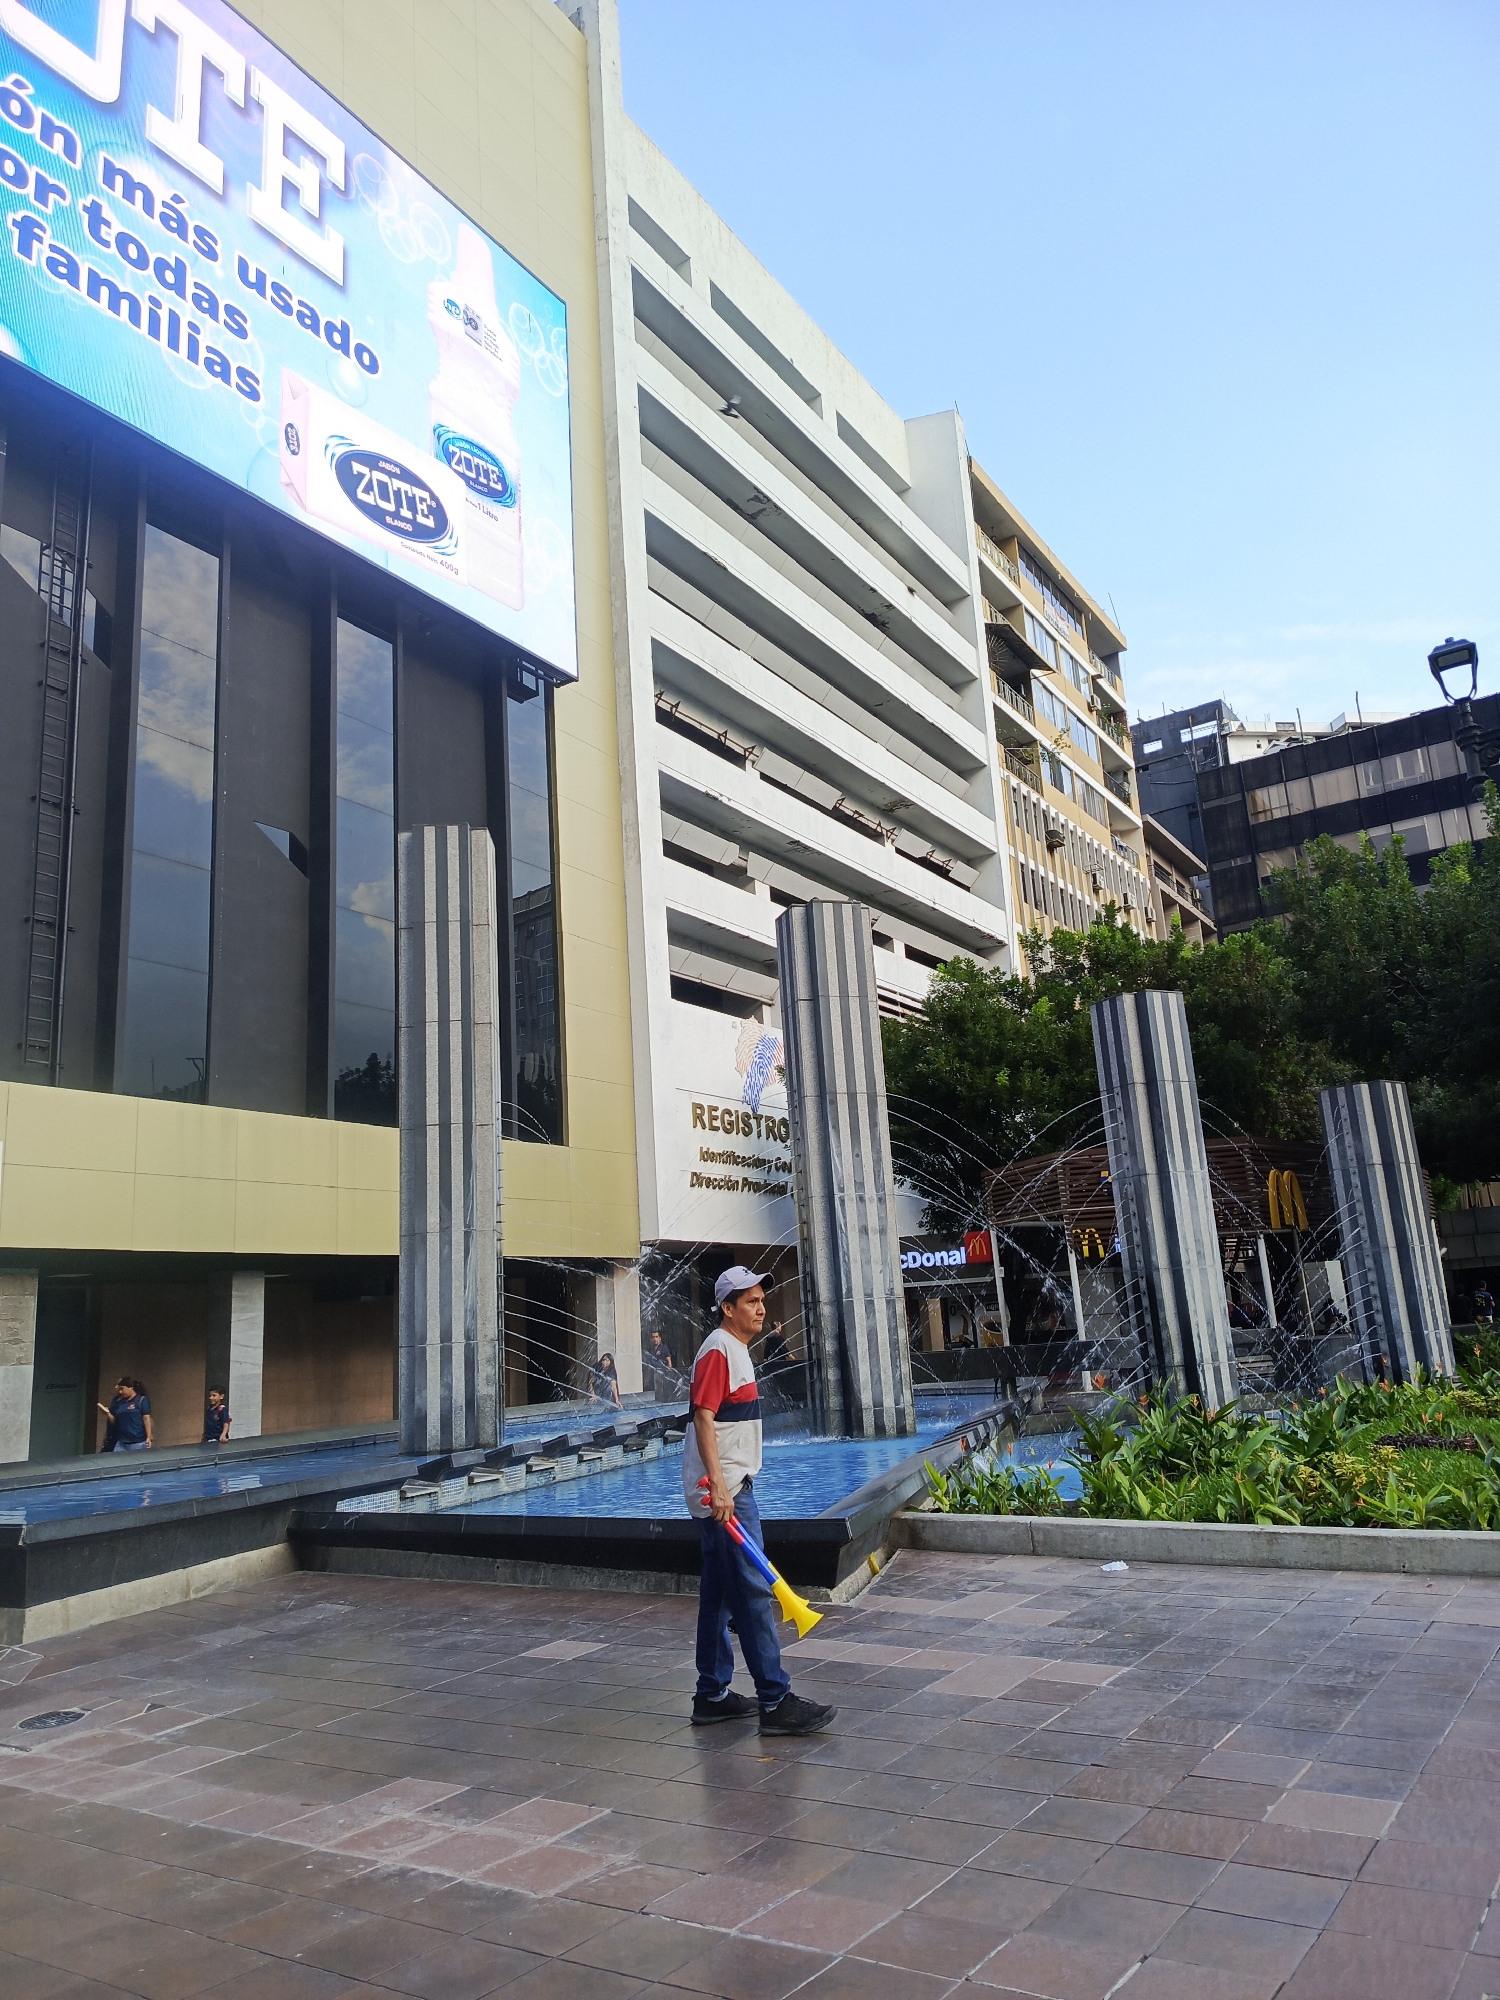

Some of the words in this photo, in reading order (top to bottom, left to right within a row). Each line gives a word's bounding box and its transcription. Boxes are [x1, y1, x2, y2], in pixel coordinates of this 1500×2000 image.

[0, 77, 78, 165] ón
[102, 156, 220, 263] más
[238, 254, 380, 375] usado
[0, 147, 67, 209] or
[83, 200, 249, 340] todas
[12, 214, 261, 402] familias
[448, 443, 503, 492] ZOTE
[469, 480, 488, 493] BLANCO
[351, 460, 436, 528] ZOTE
[482, 506, 499, 521] Litro
[385, 515, 413, 532] BLANCO
[691, 1102, 791, 1144] REGISTRO
[699, 1146, 767, 1170] Identificación
[690, 1171, 740, 1192] Dirección
[741, 1176, 789, 1196] Provincial
